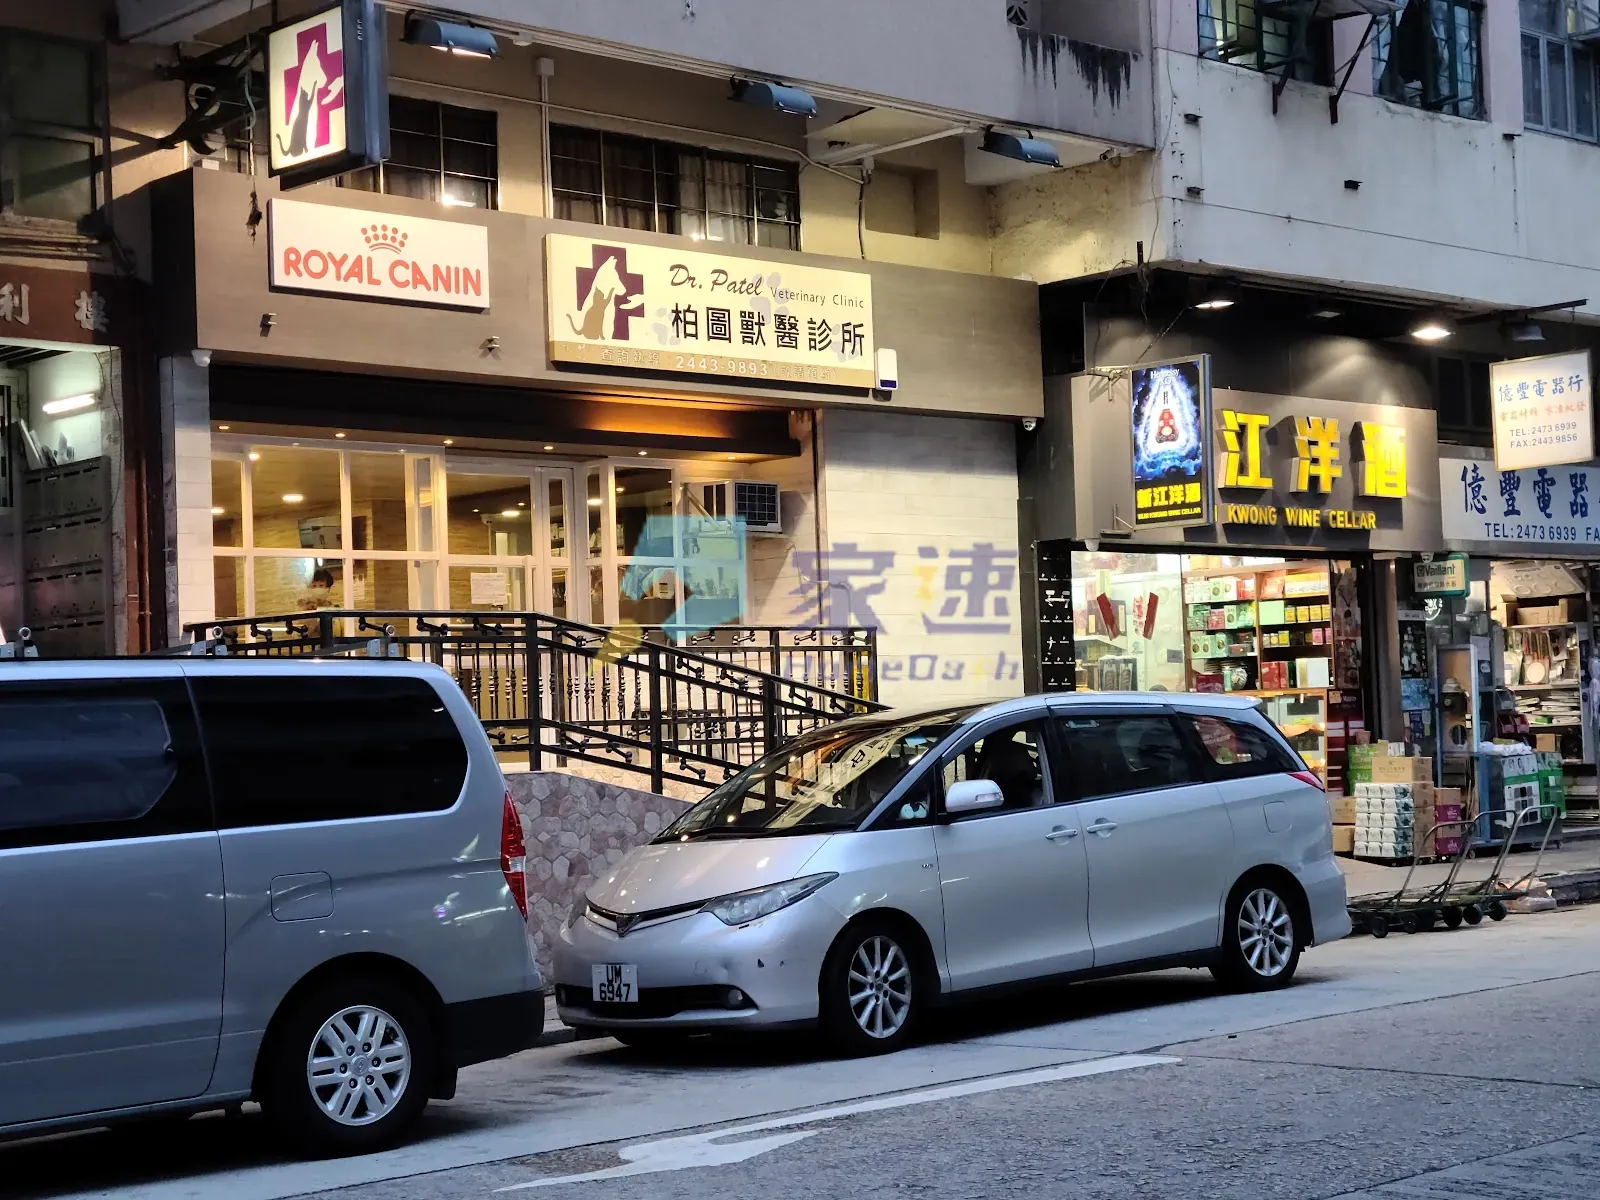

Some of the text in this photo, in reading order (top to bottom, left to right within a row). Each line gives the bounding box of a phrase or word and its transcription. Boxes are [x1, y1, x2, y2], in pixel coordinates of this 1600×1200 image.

[284, 247, 481, 296] ROYAL CANIN
[669, 264, 864, 308] Dr. Patel Veterinary Clinic
[671, 303, 865, 356] 柏圖獸醫診所
[675, 355, 769, 377] 2443-9893
[1499, 374, 1584, 402] 億豐電器行
[1227, 503, 1278, 526] KWONG
[1285, 507, 1320, 528] WINE
[1329, 510, 1376, 529] CELLAR
[606, 965, 622, 984] UM
[599, 982, 631, 1002] 6947
